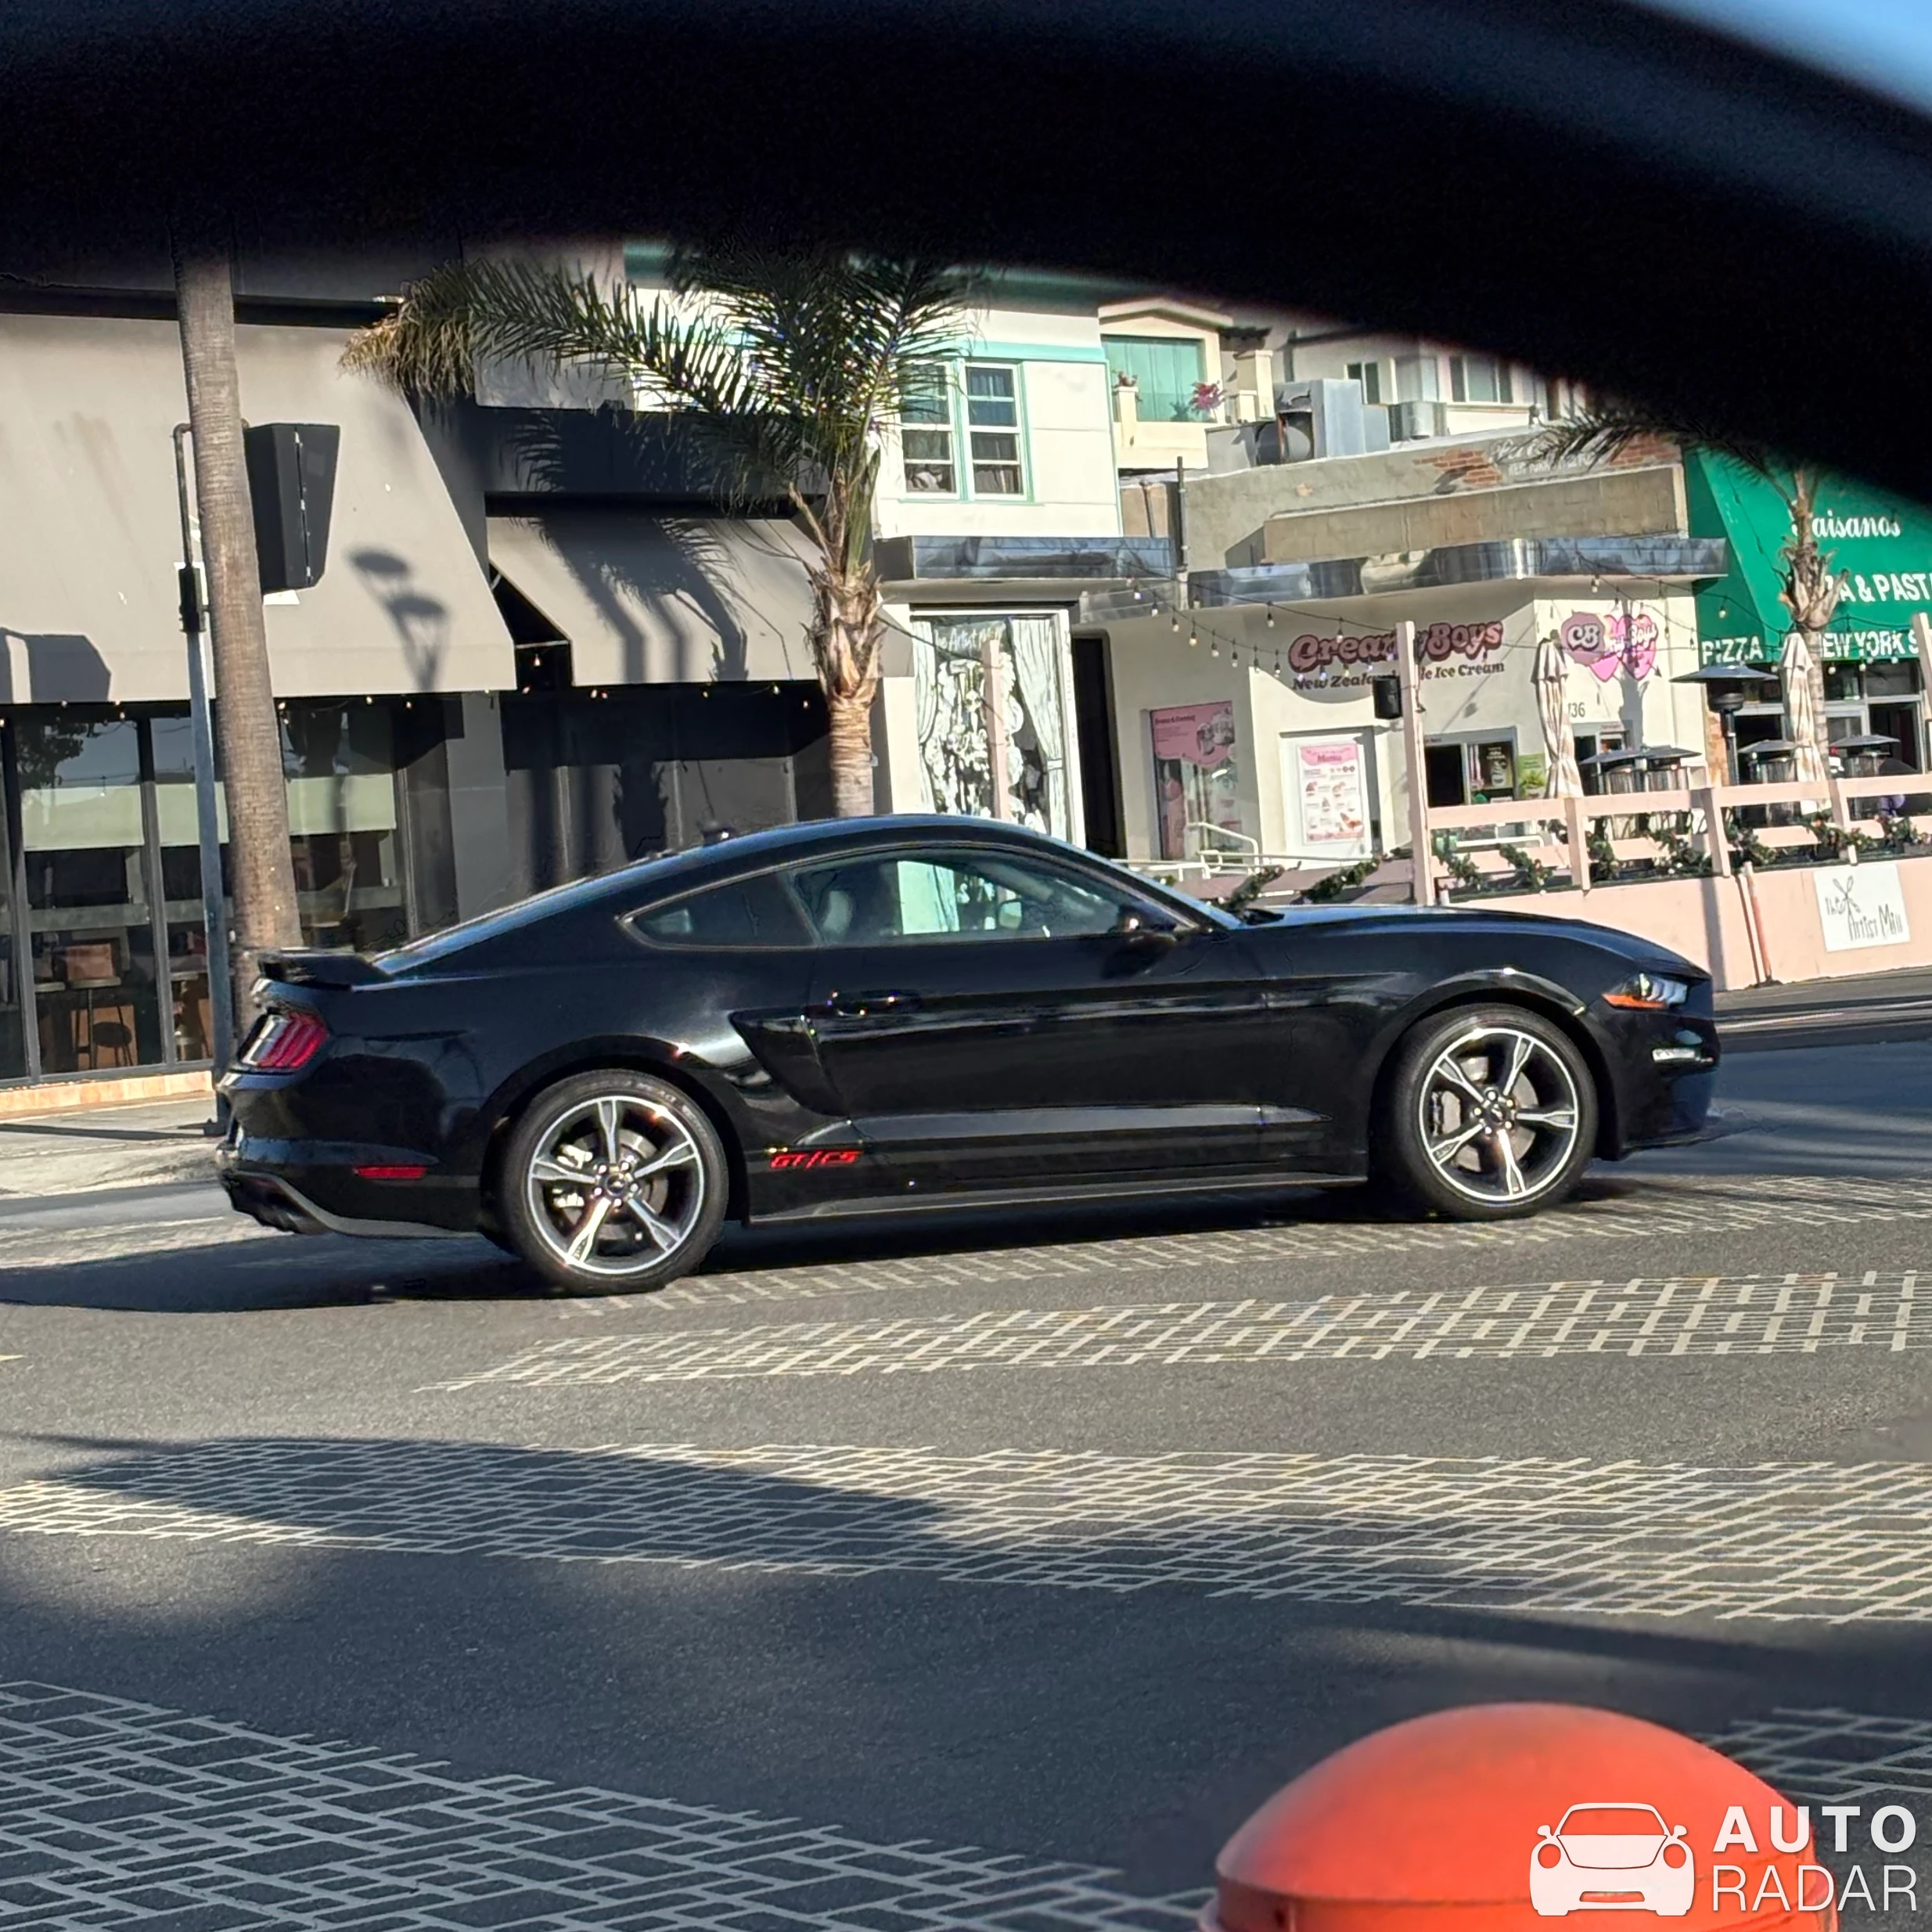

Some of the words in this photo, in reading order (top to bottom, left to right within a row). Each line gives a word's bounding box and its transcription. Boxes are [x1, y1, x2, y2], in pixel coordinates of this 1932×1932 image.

[1789, 502, 1901, 538] aisanos
[1872, 572, 1932, 602] PAST
[1701, 635, 1764, 665] PIZZA
[1822, 632, 1852, 658] EW
[1854, 629, 1905, 657] YORK
[1293, 676, 1329, 690] New
[1434, 666, 1455, 678] Ice
[1458, 662, 1506, 677] Cream
